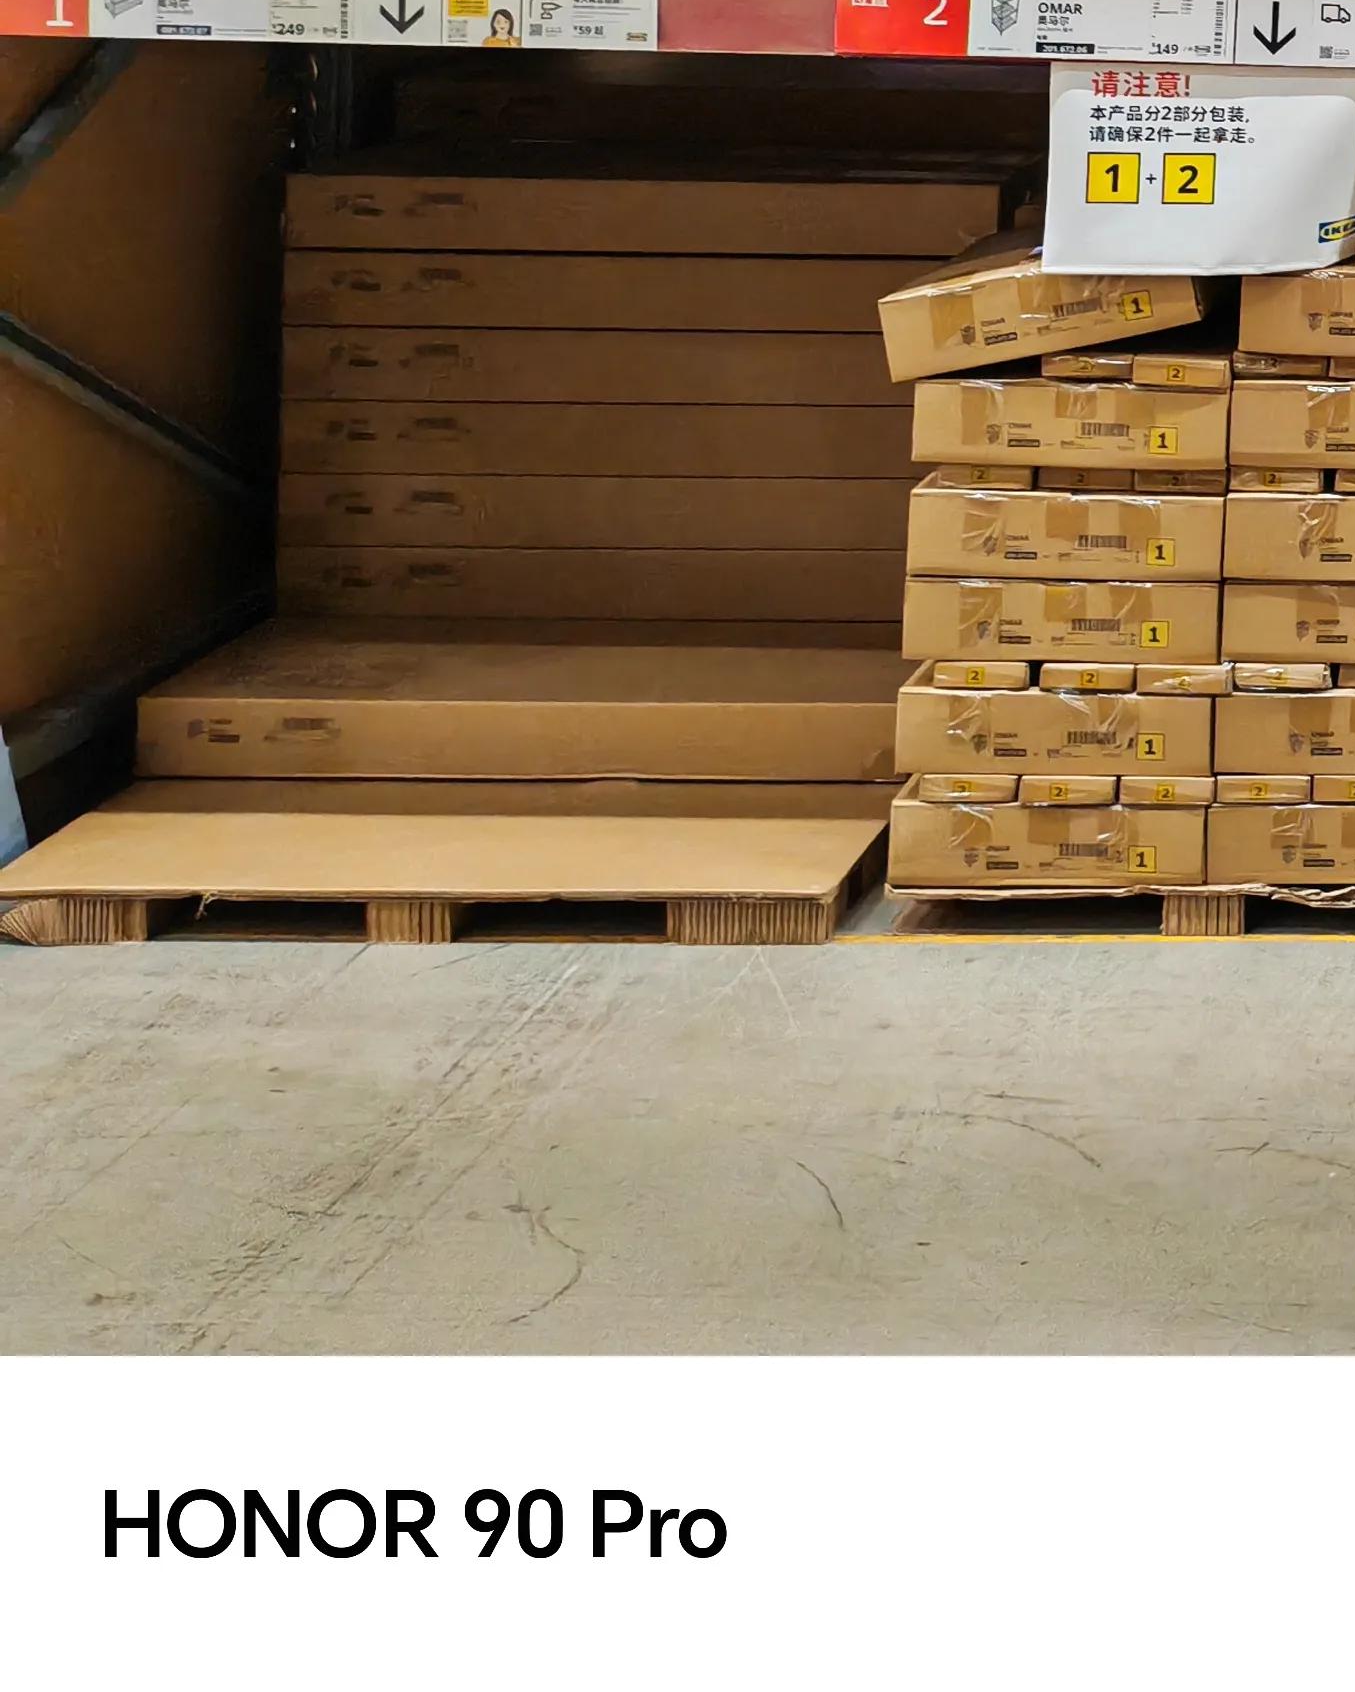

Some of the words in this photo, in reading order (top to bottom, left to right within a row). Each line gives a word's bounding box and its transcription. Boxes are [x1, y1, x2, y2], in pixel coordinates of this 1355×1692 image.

[1037, 2, 1083, 15] OMAR
[1091, 71, 1191, 98] 请注意!
[1089, 106, 1251, 124] 本产品分2部分包装,
[1089, 126, 1256, 144] 请确保2件一起拿走。
[1105, 163, 1120, 193] 1
[1178, 164, 1199, 194] 2
